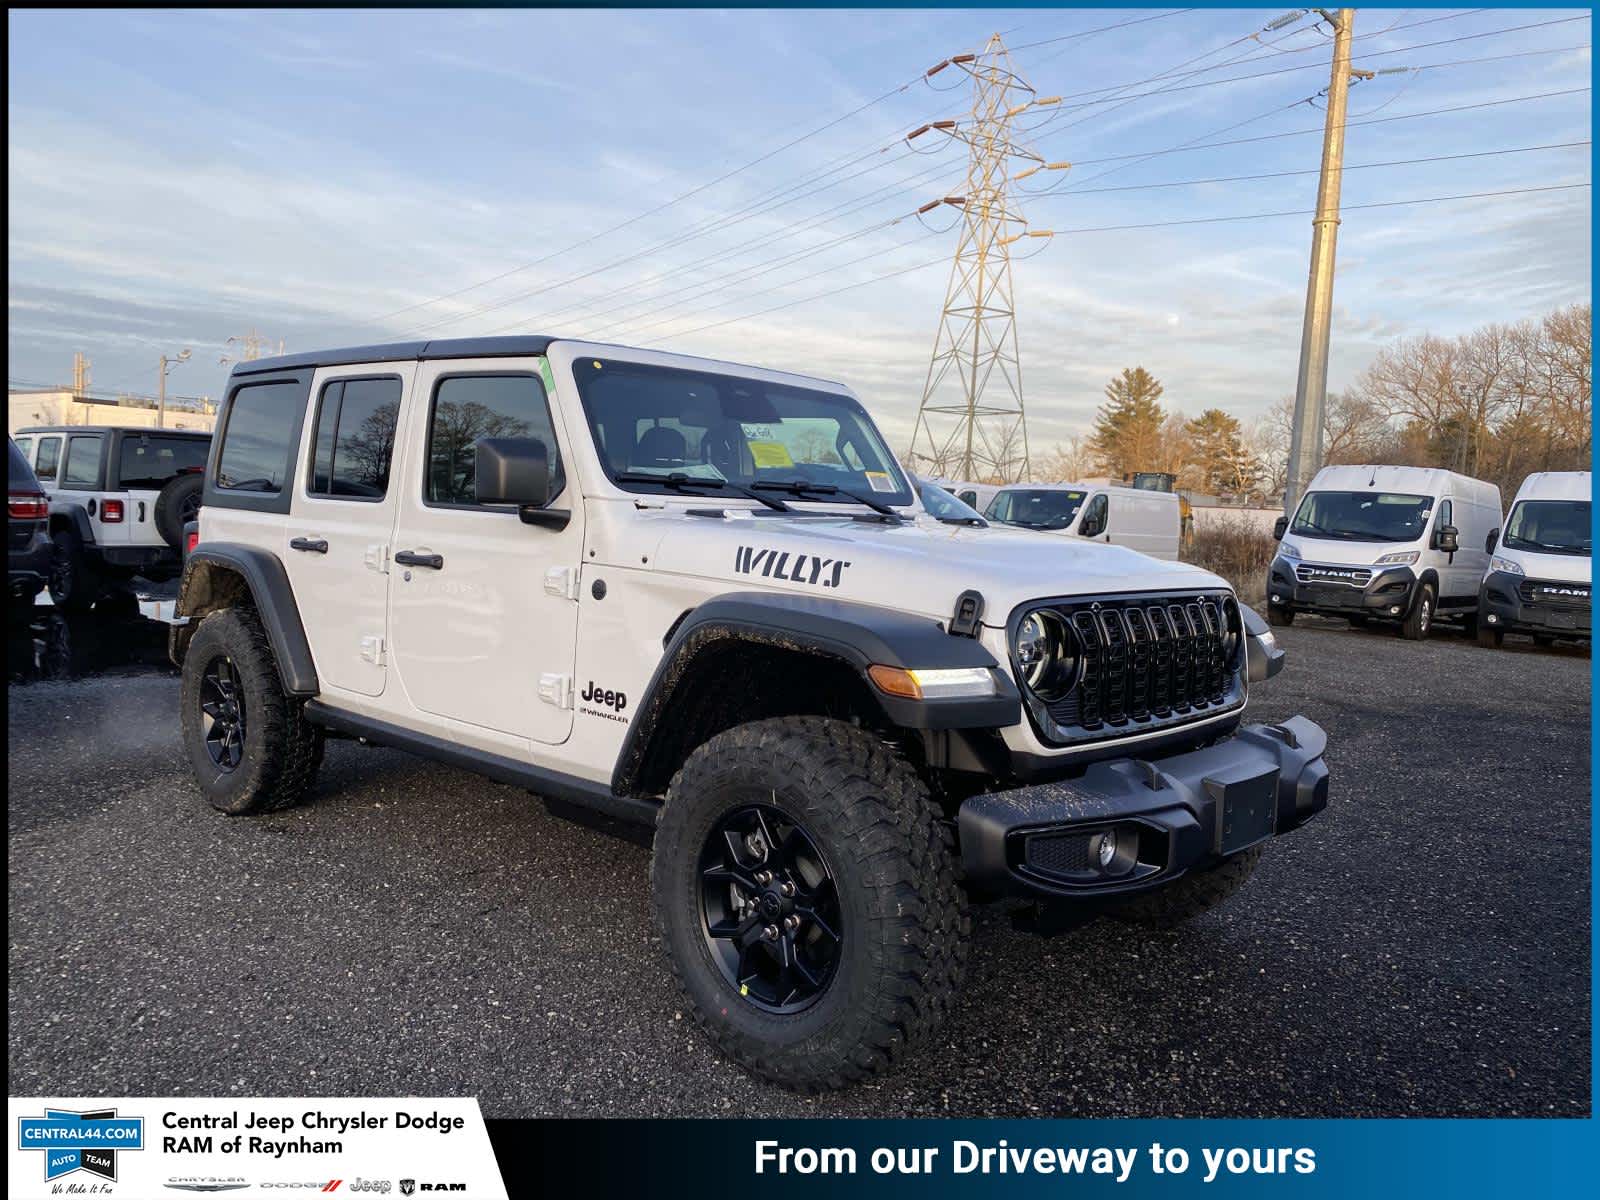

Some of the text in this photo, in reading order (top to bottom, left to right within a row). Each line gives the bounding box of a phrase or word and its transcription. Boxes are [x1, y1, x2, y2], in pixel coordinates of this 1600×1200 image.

[735, 545, 851, 588] WILLYS
[1315, 569, 1351, 578] RAM
[1543, 587, 1588, 596] RAM
[581, 680, 627, 712] Jeep
